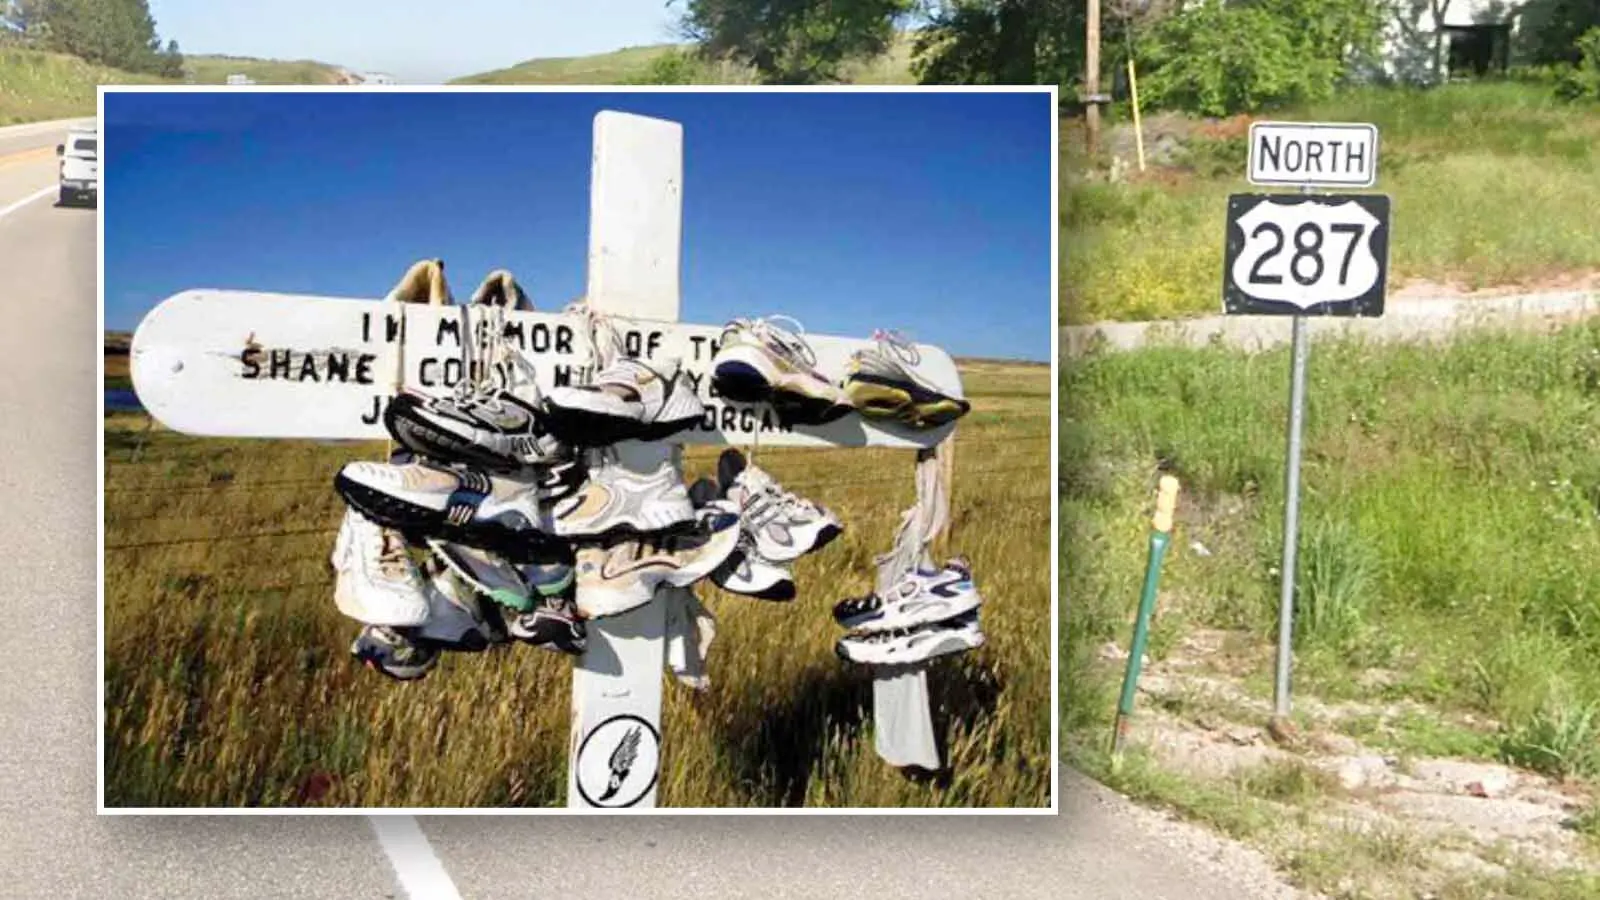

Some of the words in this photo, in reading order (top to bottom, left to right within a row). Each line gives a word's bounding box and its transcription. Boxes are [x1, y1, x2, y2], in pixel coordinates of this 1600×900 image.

[1259, 135, 1364, 173] NORTH
[1248, 221, 1366, 286] 287
[362, 312, 405, 343] IN
[436, 317, 576, 354] MEMOR
[625, 330, 663, 359] OF
[240, 347, 377, 384] SHANE
